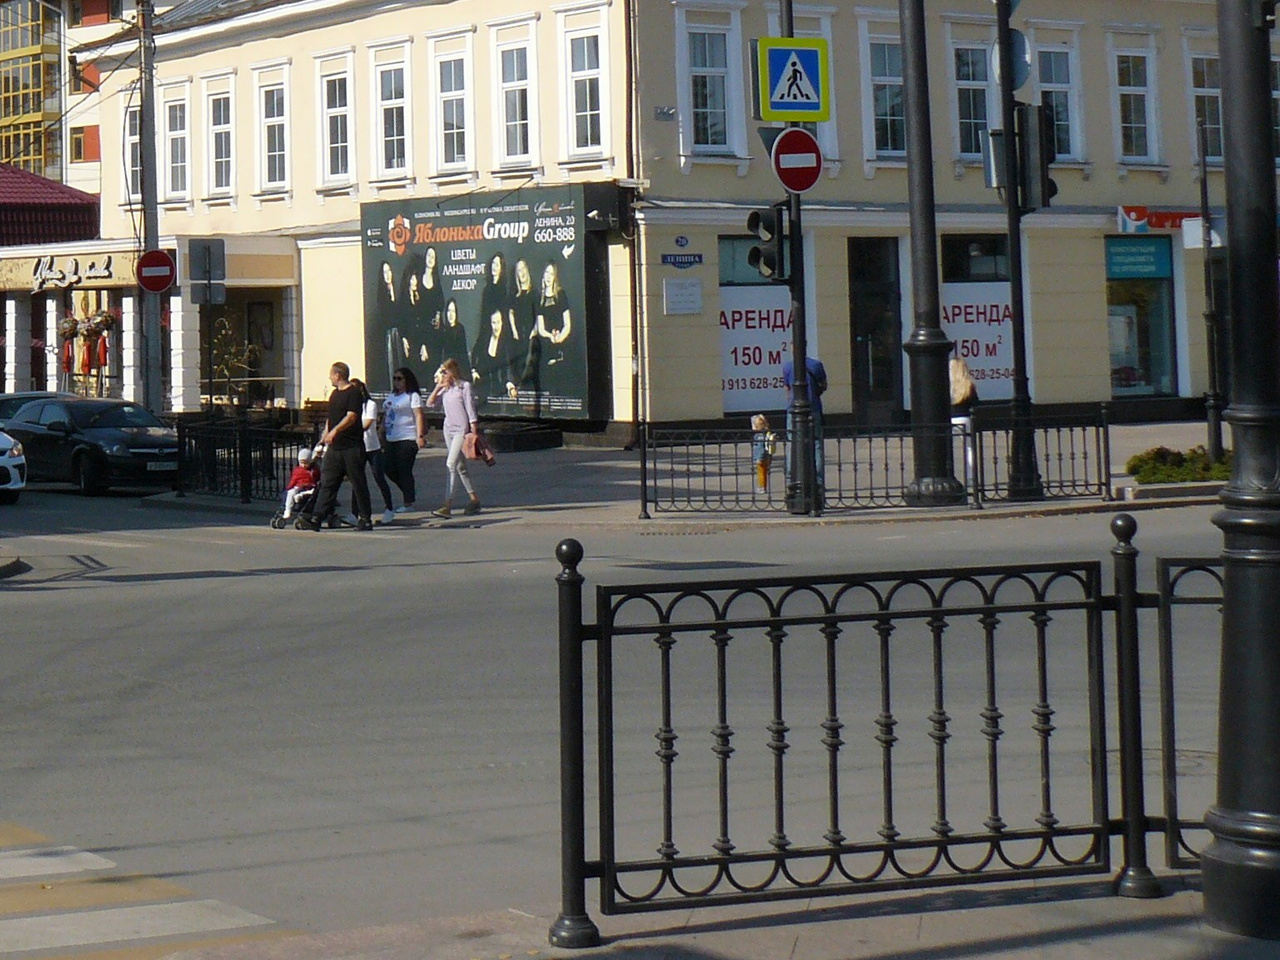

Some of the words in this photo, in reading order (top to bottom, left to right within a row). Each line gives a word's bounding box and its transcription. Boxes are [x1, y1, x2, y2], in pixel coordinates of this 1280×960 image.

[534, 227, 575, 243] 660-888
[451, 248, 476, 260] ЦВЕТЫ
[442, 263, 485, 276] ЛАНДШАФТ
[451, 279, 477, 291] ДЕКОР
[954, 339, 980, 357] 150
[730, 346, 762, 366] 150
[727, 378, 747, 390] 913
[749, 377, 785, 390] 628-25
